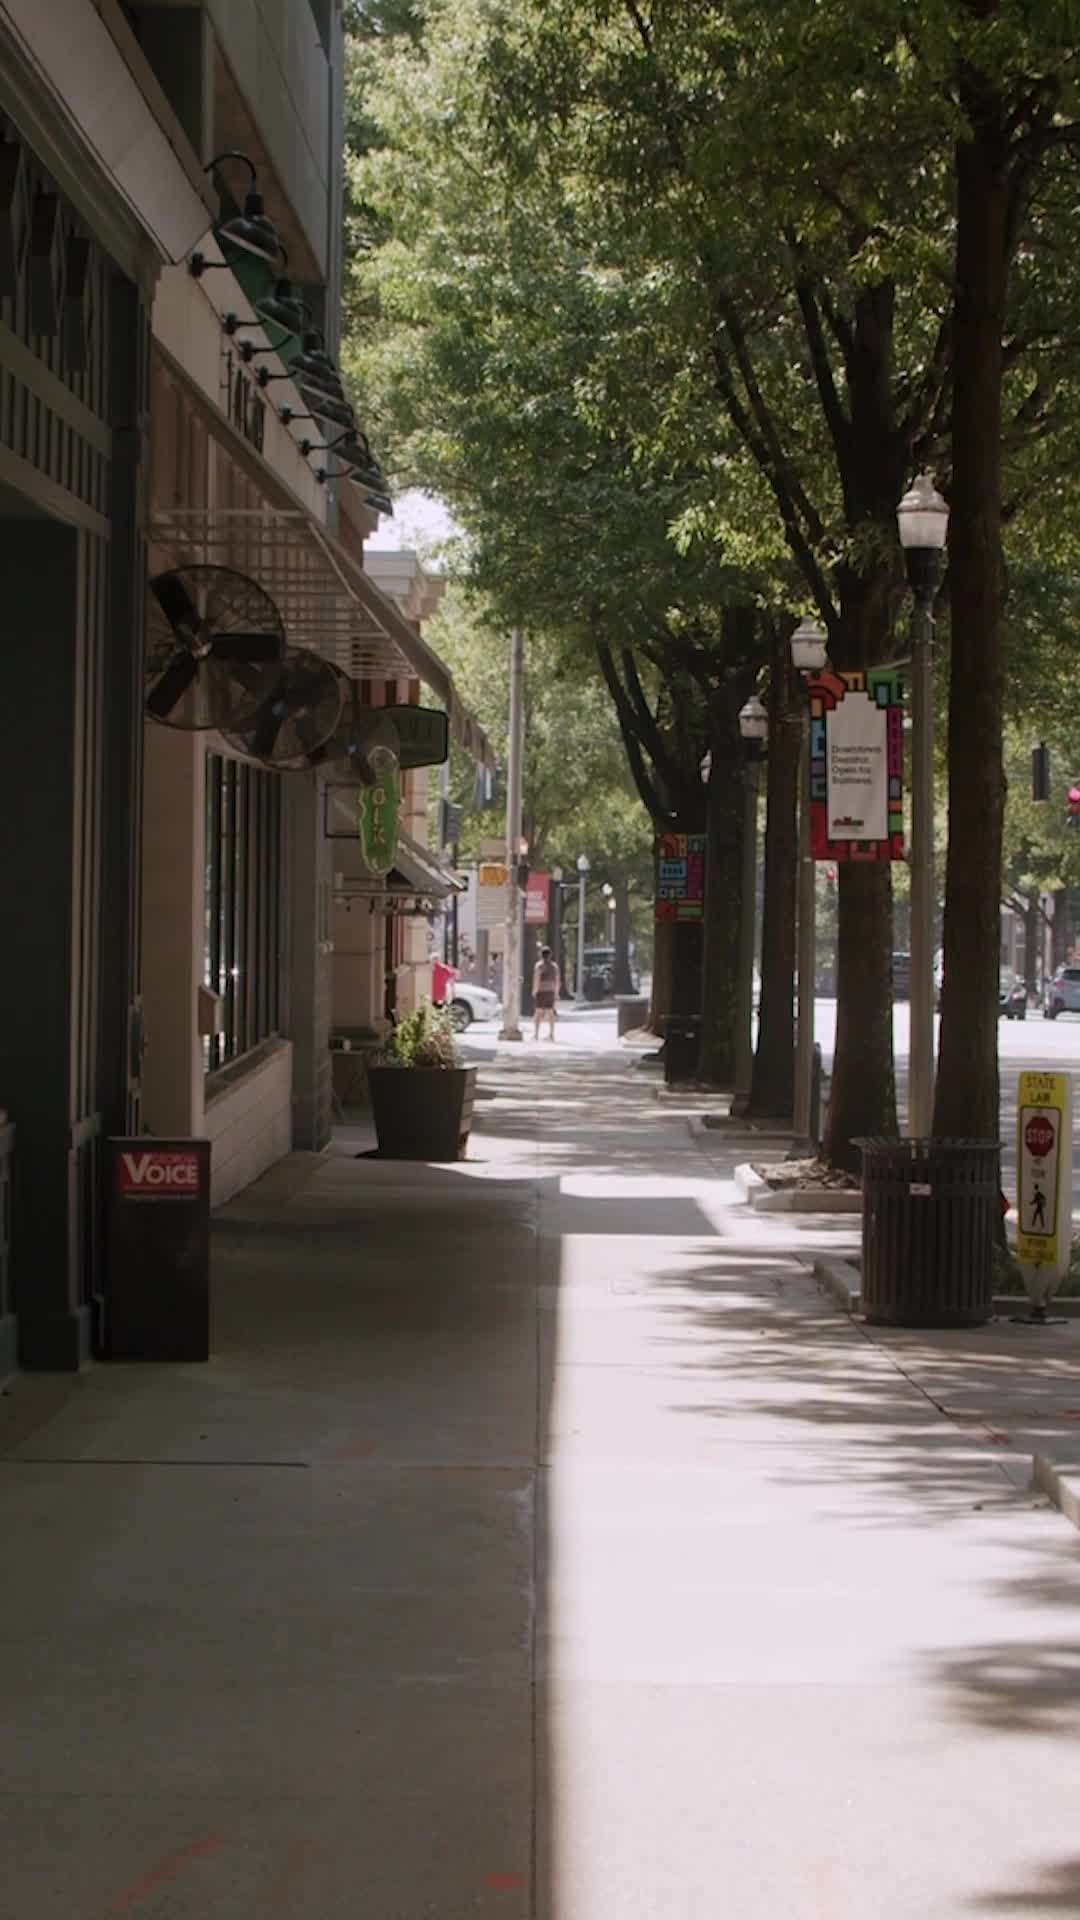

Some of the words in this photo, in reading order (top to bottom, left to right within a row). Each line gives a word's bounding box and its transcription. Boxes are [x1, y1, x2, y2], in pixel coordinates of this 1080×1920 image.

[1025, 1076, 1056, 1089] STATE
[1030, 1092, 1051, 1104] LAW
[1026, 1128, 1054, 1145] STOP
